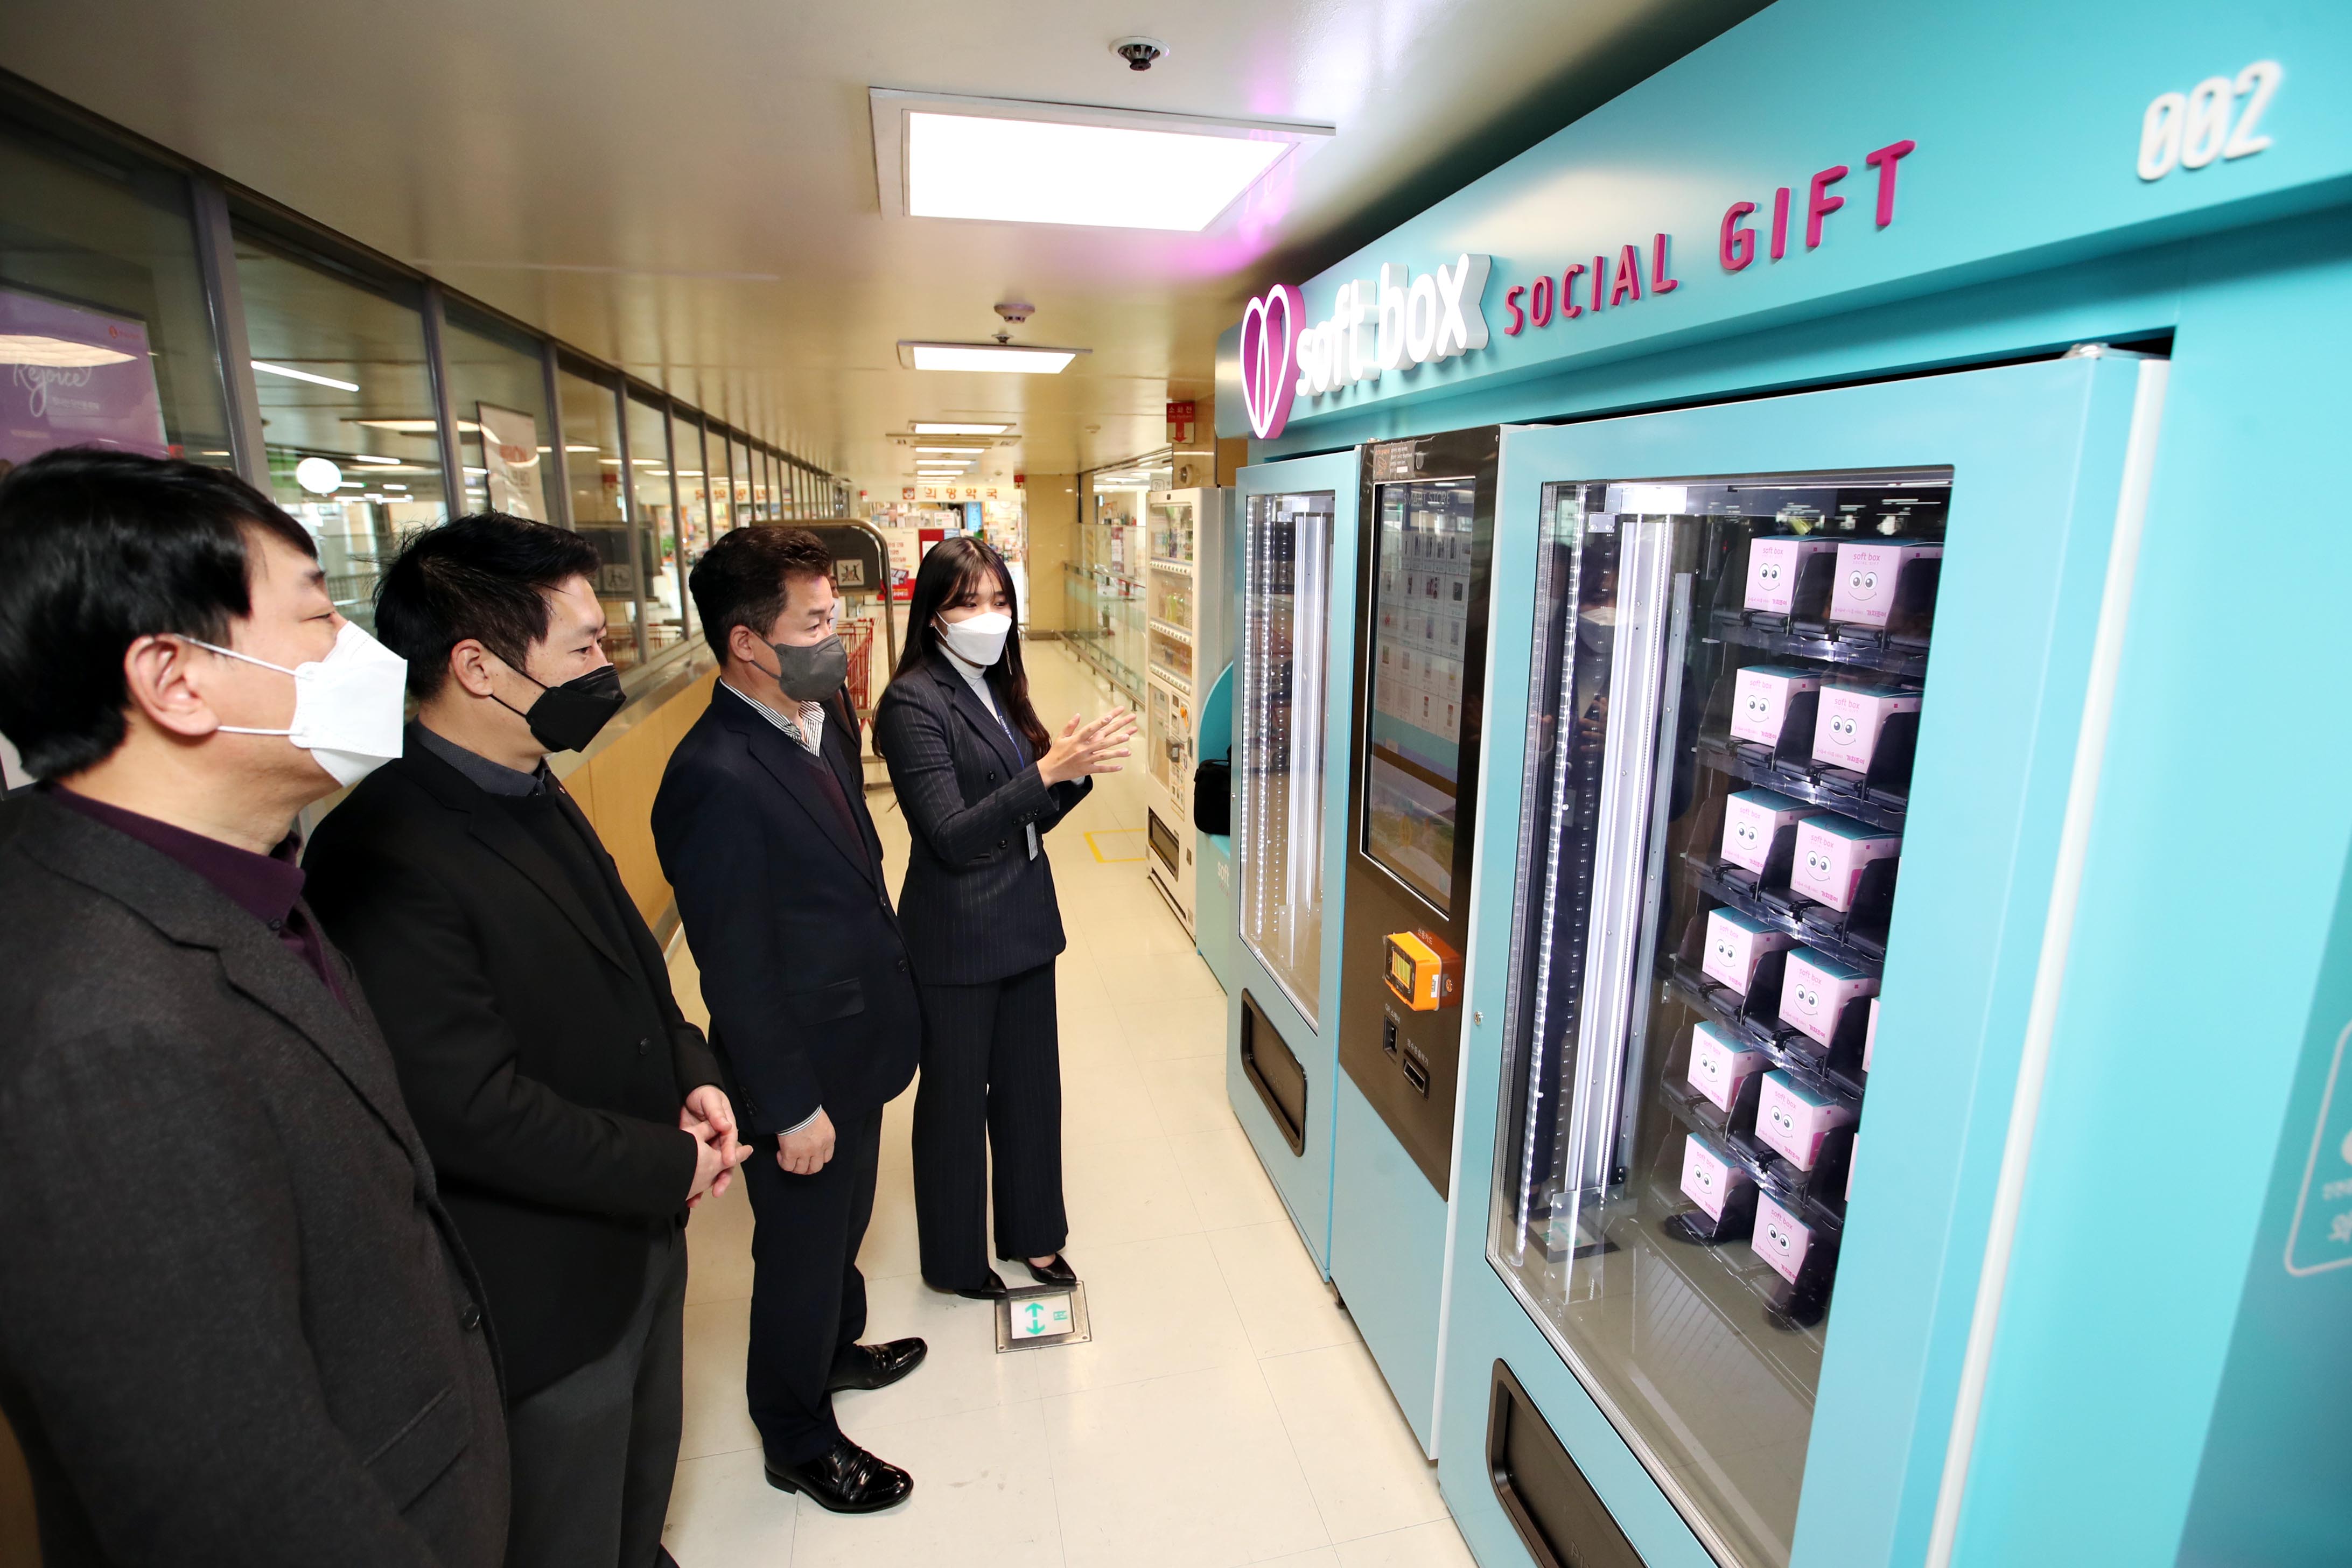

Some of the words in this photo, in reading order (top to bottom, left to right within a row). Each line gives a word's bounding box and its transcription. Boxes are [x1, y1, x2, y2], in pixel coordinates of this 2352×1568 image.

[2137, 59, 2283, 181] 002
[1504, 233, 1678, 335] SOCIAL
[1720, 139, 1916, 270] GIFT
[1296, 279, 1380, 396] soft
[1378, 253, 1491, 370] box
[1429, 491, 1450, 505] STORE
[1853, 552, 1866, 561] soft
[1868, 553, 1880, 561] box
[1835, 698, 1846, 706] soft
[1849, 700, 1860, 709] box
[1771, 1209, 1782, 1221] soft
[1783, 1217, 1793, 1230] box
